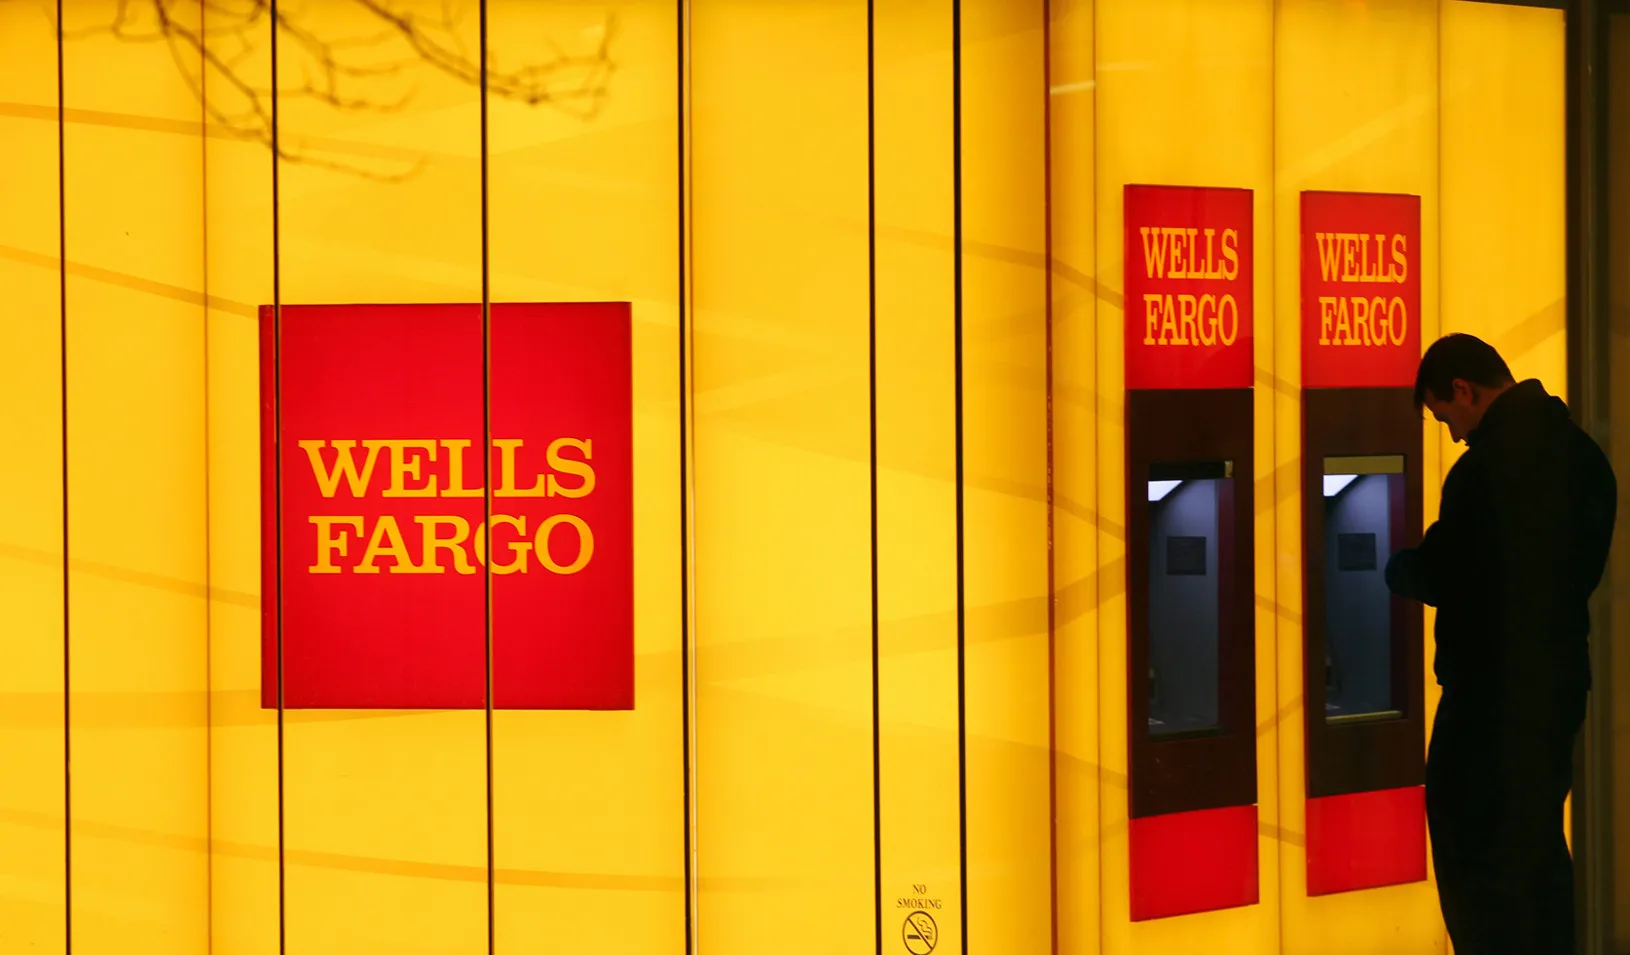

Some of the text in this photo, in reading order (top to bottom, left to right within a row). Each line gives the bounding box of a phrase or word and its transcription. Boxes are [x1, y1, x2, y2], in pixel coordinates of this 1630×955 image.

[1140, 227, 1239, 281] WELLS
[1315, 232, 1408, 284] WELLS
[1143, 293, 1238, 346] FARGO
[1318, 296, 1407, 346] FARGO
[299, 437, 596, 499] WELLS
[308, 513, 595, 575] FARGO
[896, 898, 942, 909] SMOKING
[912, 884, 927, 895] NO
